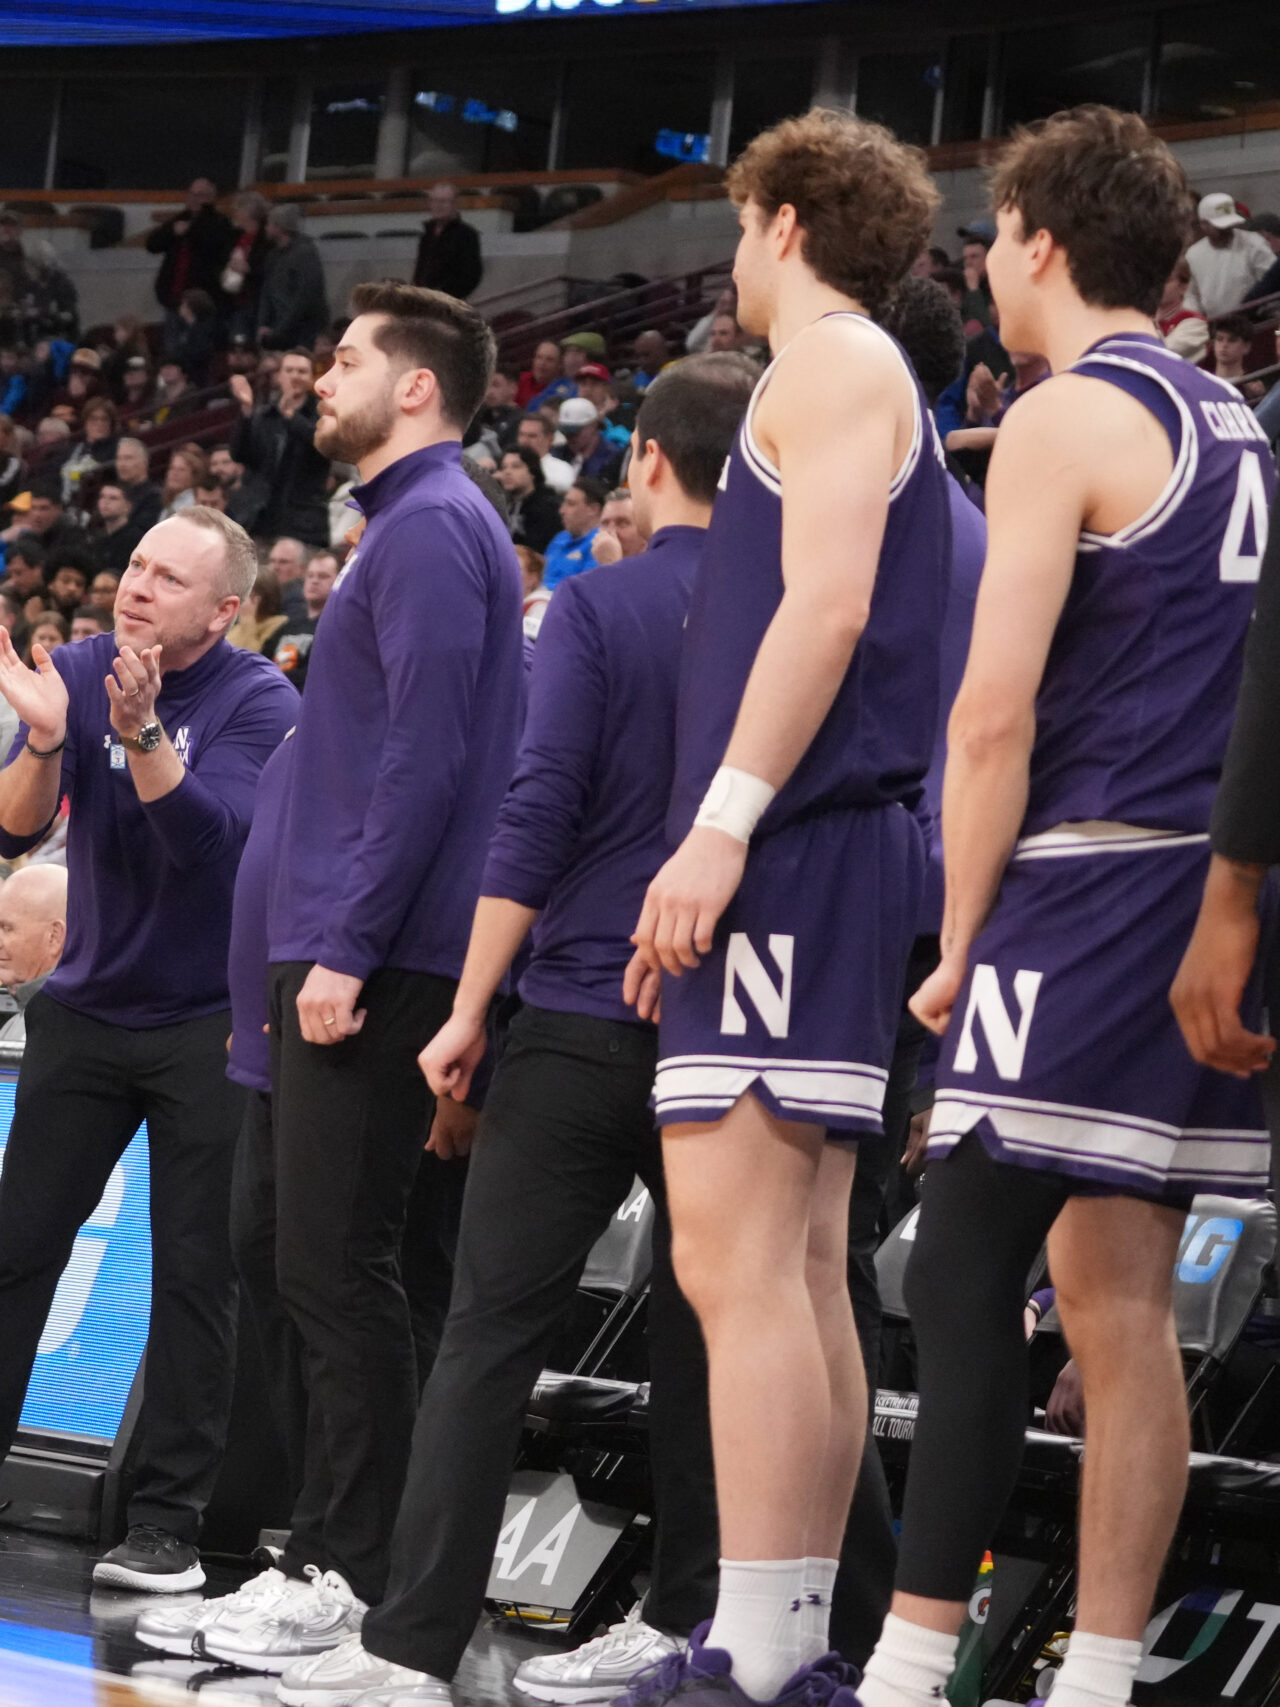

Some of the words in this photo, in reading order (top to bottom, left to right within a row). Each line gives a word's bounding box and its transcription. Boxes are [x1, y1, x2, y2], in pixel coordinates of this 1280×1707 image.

[1219, 448, 1269, 582] 4
[720, 932, 795, 1039] N
[952, 963, 1044, 1081] N
